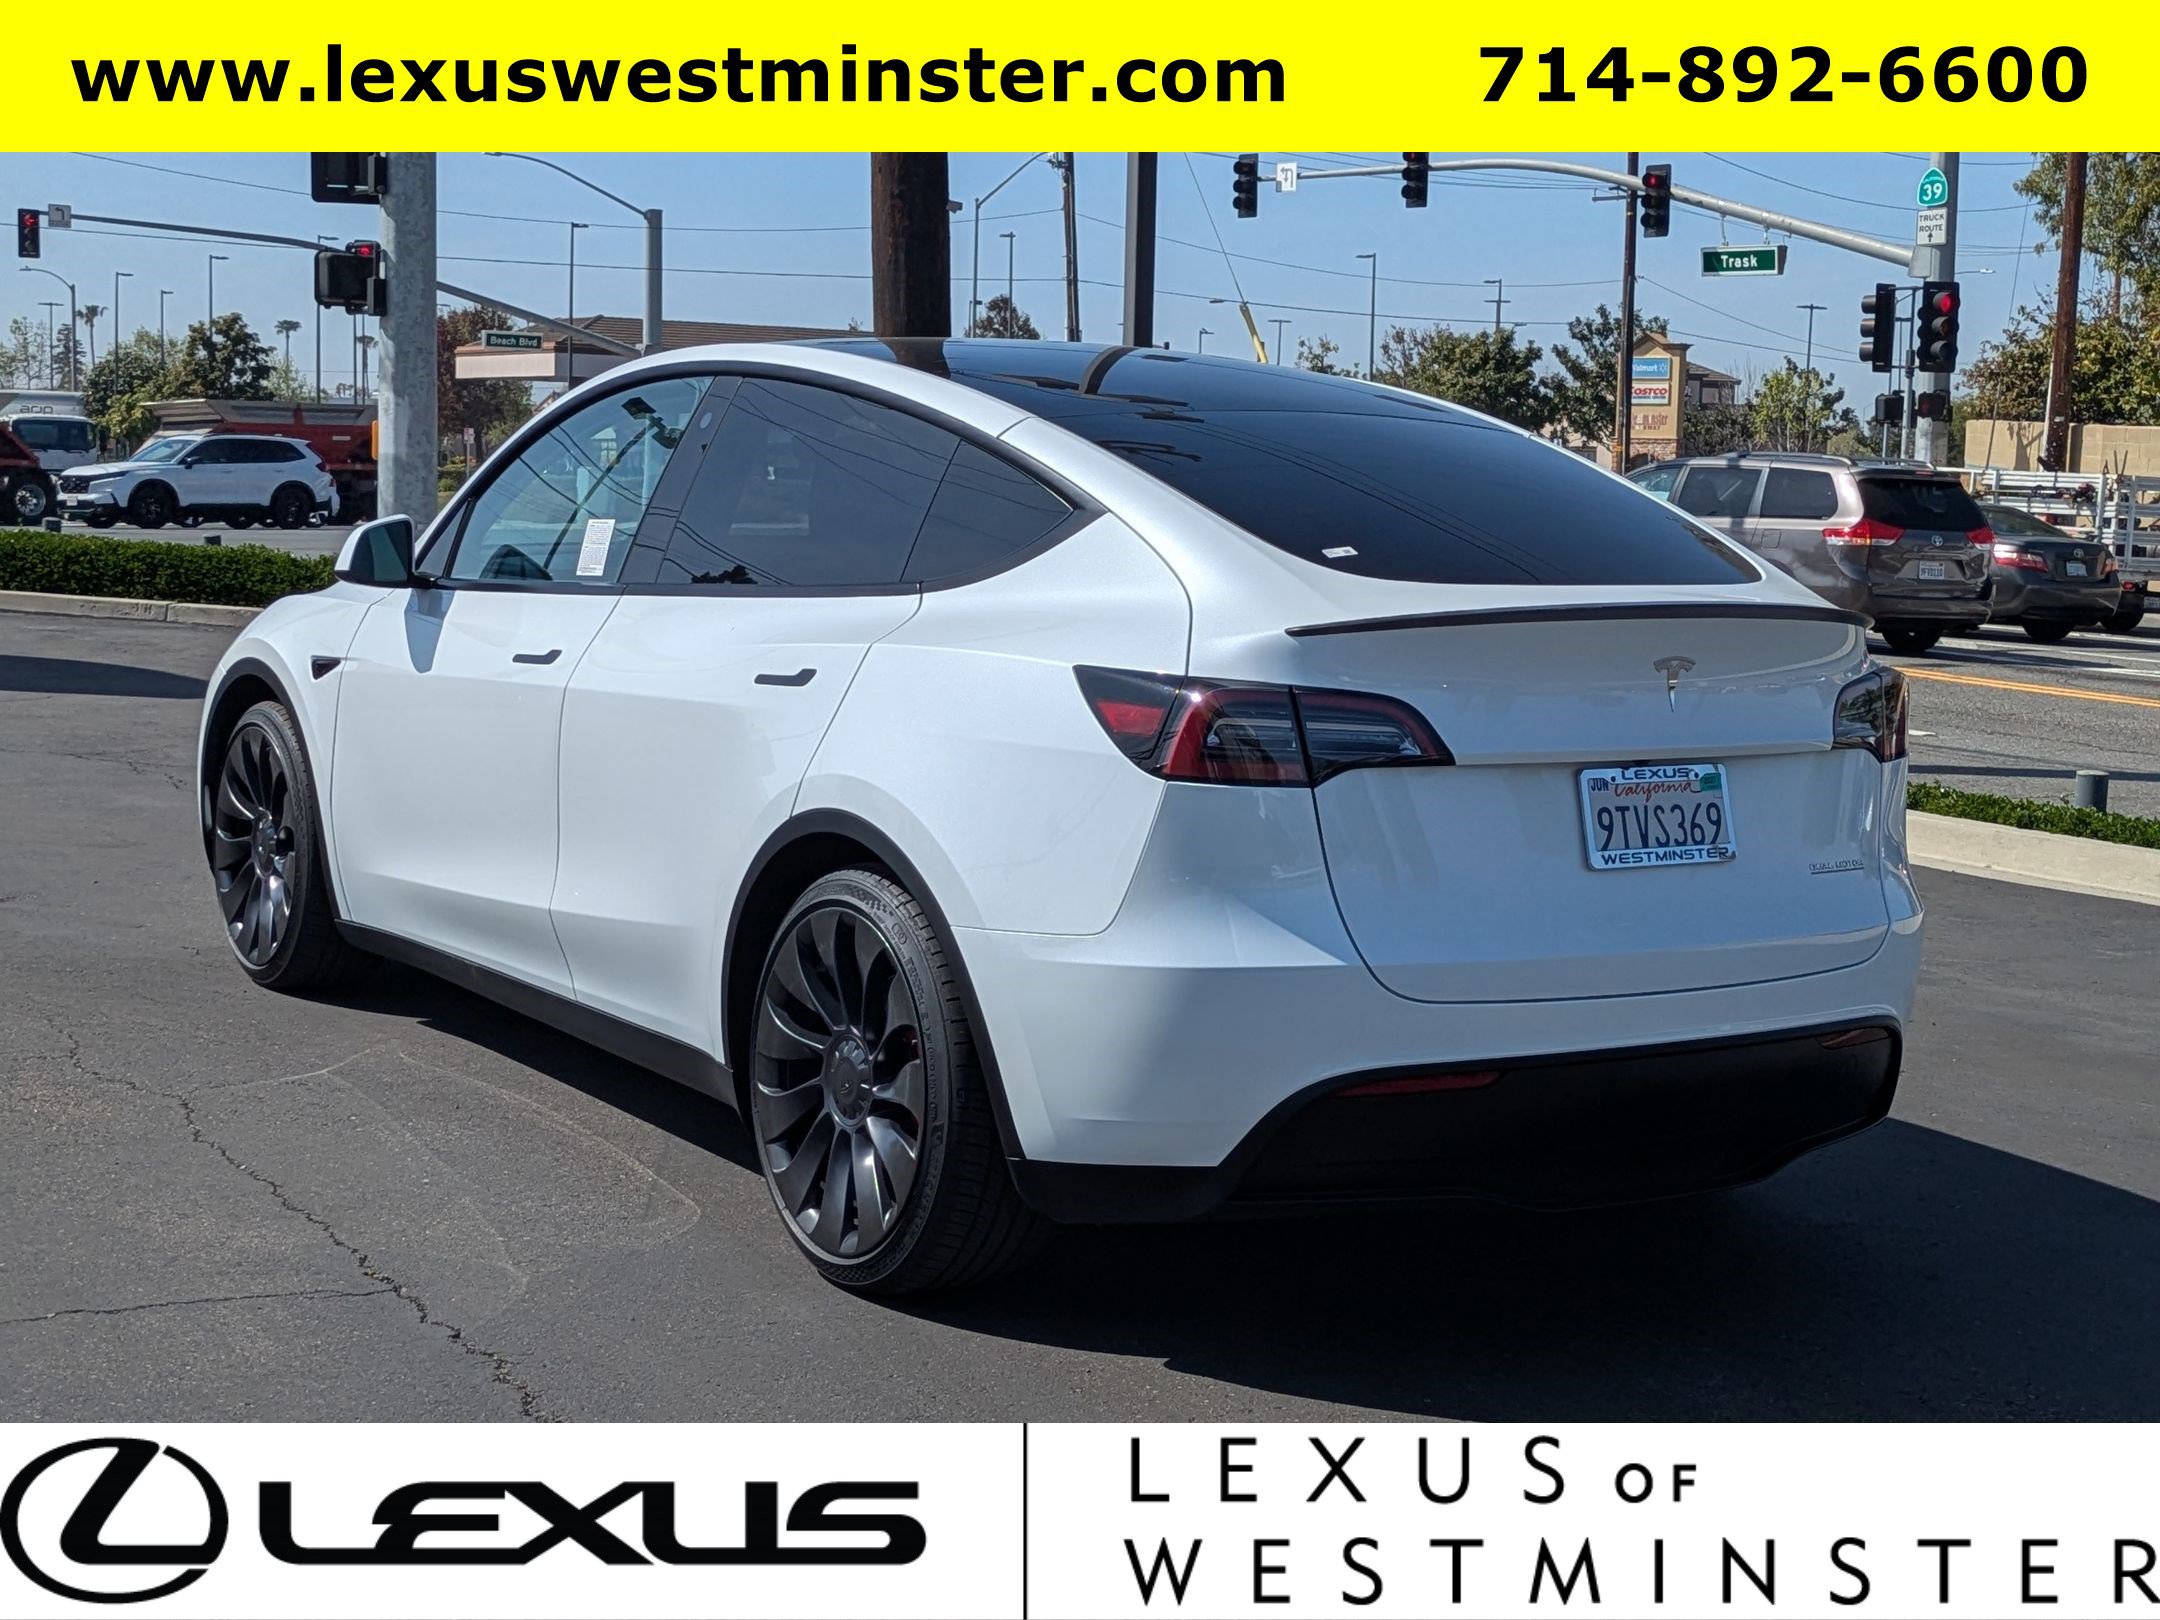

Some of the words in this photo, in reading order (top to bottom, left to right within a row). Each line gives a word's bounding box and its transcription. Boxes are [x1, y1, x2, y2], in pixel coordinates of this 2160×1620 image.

[1922, 183, 1942, 201] 39
[1919, 213, 1945, 222] TRUCK
[1919, 224, 1943, 233] ROUTE
[1720, 254, 1758, 268] Trask
[490, 335, 516, 345] Beach
[519, 337, 538, 347] Blvd
[1621, 767, 1690, 781] LEXUS
[1590, 778, 1609, 792] JUN
[1615, 781, 1700, 802] California
[1597, 802, 1722, 851] 9TVS369
[1601, 846, 1730, 865] WESTMINSTER
